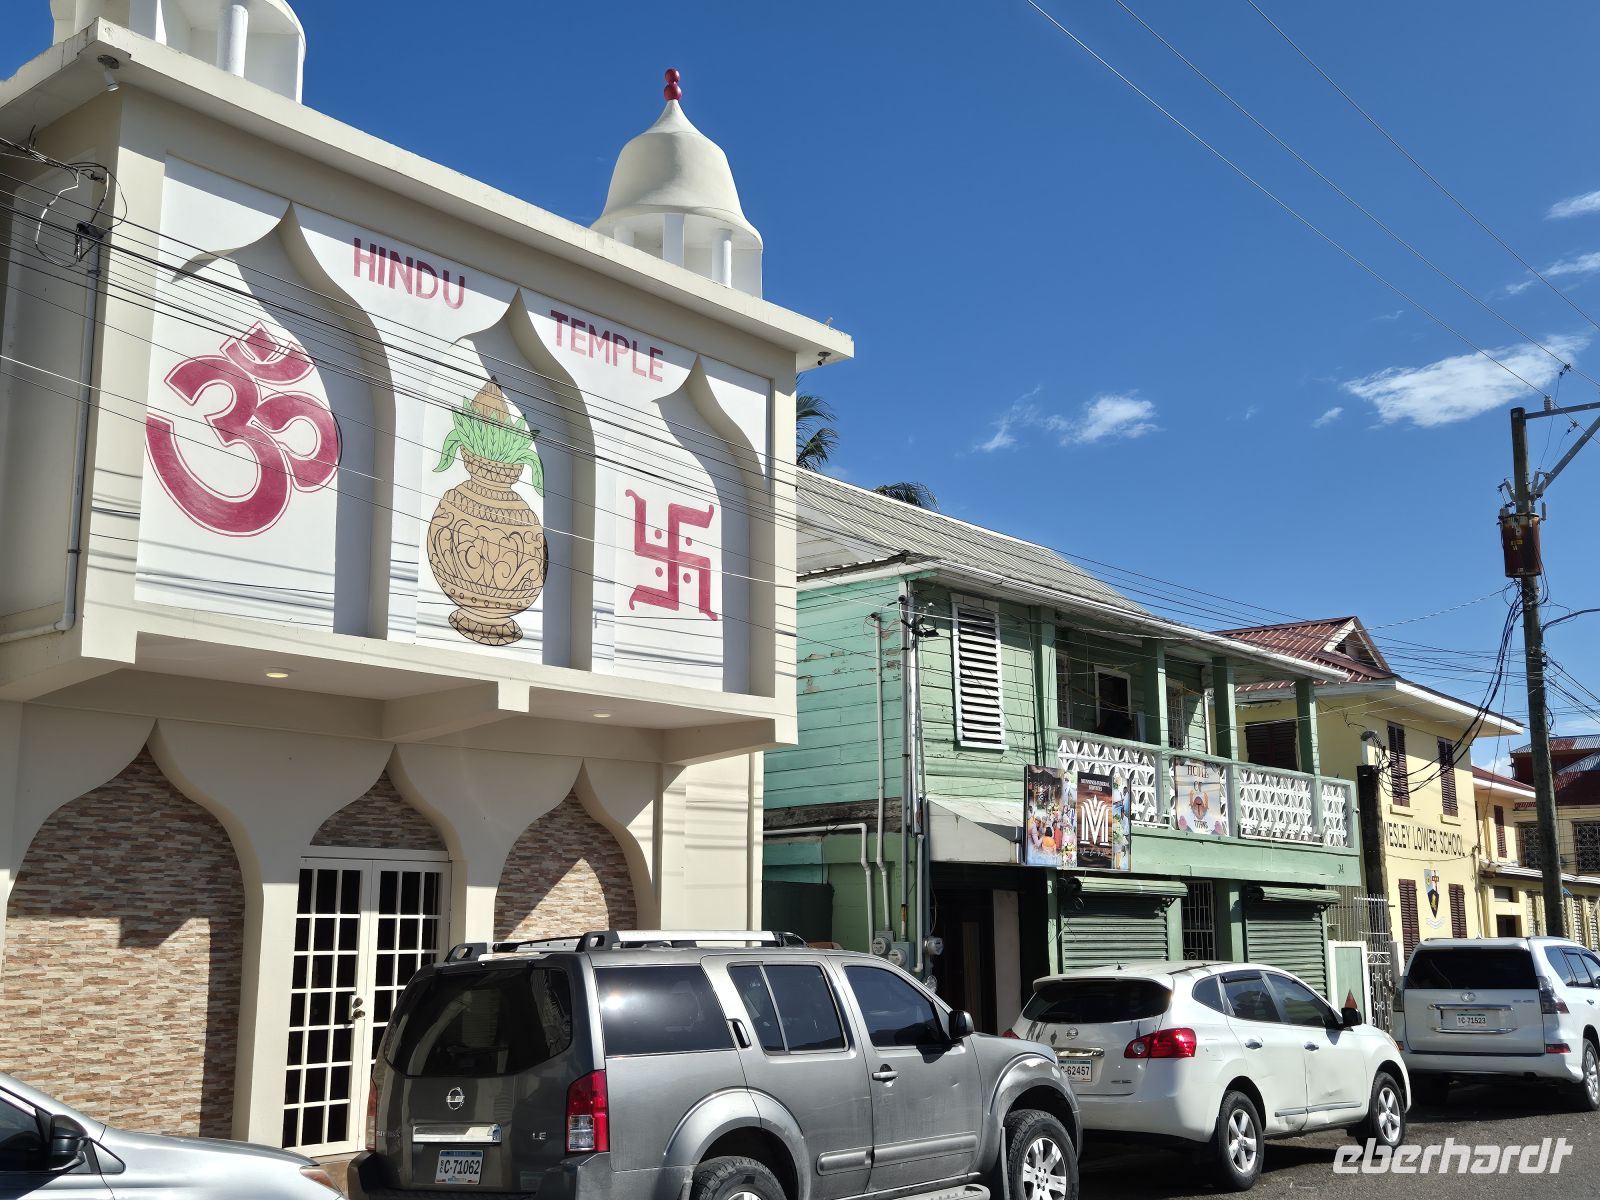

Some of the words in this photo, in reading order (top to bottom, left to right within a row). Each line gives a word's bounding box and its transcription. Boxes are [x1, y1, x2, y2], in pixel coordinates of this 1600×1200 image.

[352, 237, 466, 310] HINDU
[550, 309, 664, 383] TEMPLE
[1412, 825, 1439, 853] LOWER
[1440, 830, 1466, 857] SCHOOL
